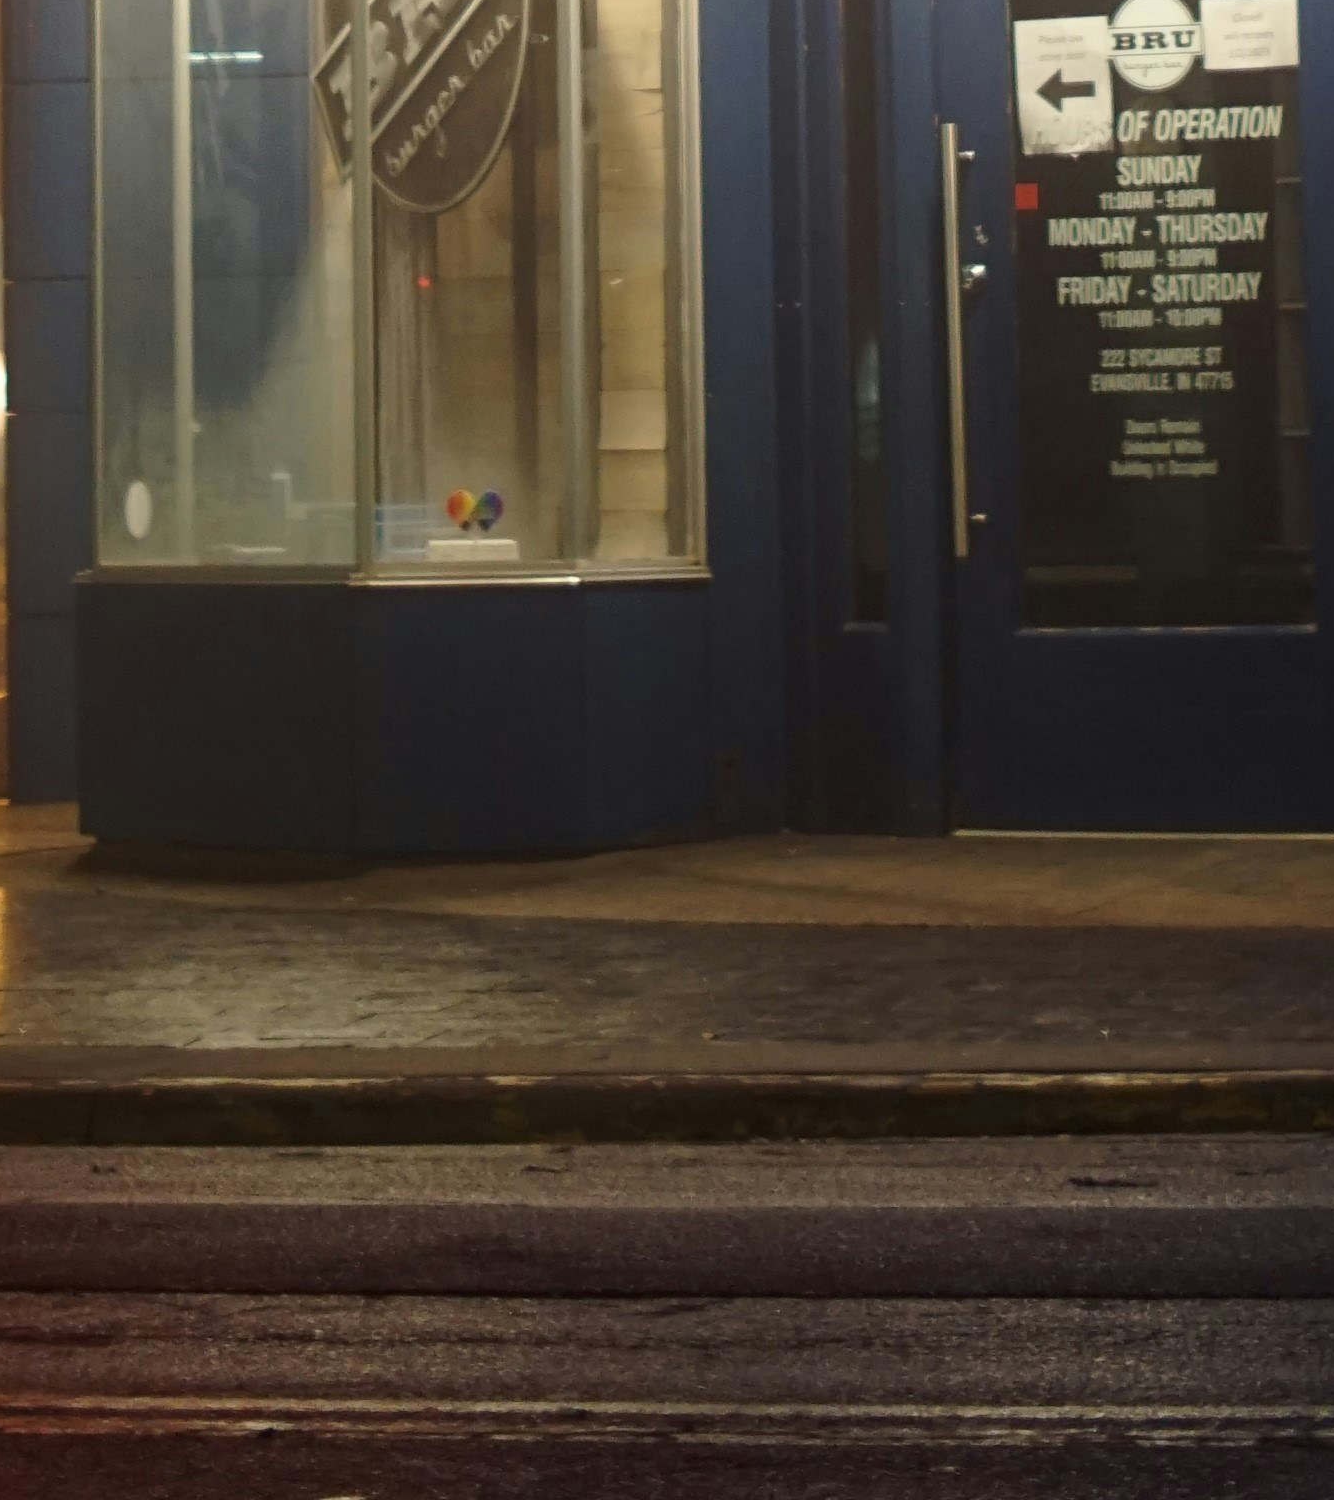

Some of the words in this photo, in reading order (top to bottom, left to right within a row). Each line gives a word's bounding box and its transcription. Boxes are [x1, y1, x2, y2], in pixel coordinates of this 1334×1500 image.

[1112, 30, 1195, 51] BRU
[384, 73, 467, 179] burger
[468, 11, 520, 70] bar
[1118, 110, 1150, 143] OF
[1154, 106, 1284, 141] OPERATION
[1117, 154, 1202, 185] SUNDAY
[1047, 217, 1137, 246] MONDAY
[1156, 212, 1269, 243] THURSDAY
[1057, 275, 1132, 306] FRIDAY
[1152, 272, 1263, 303] SATURDAY
